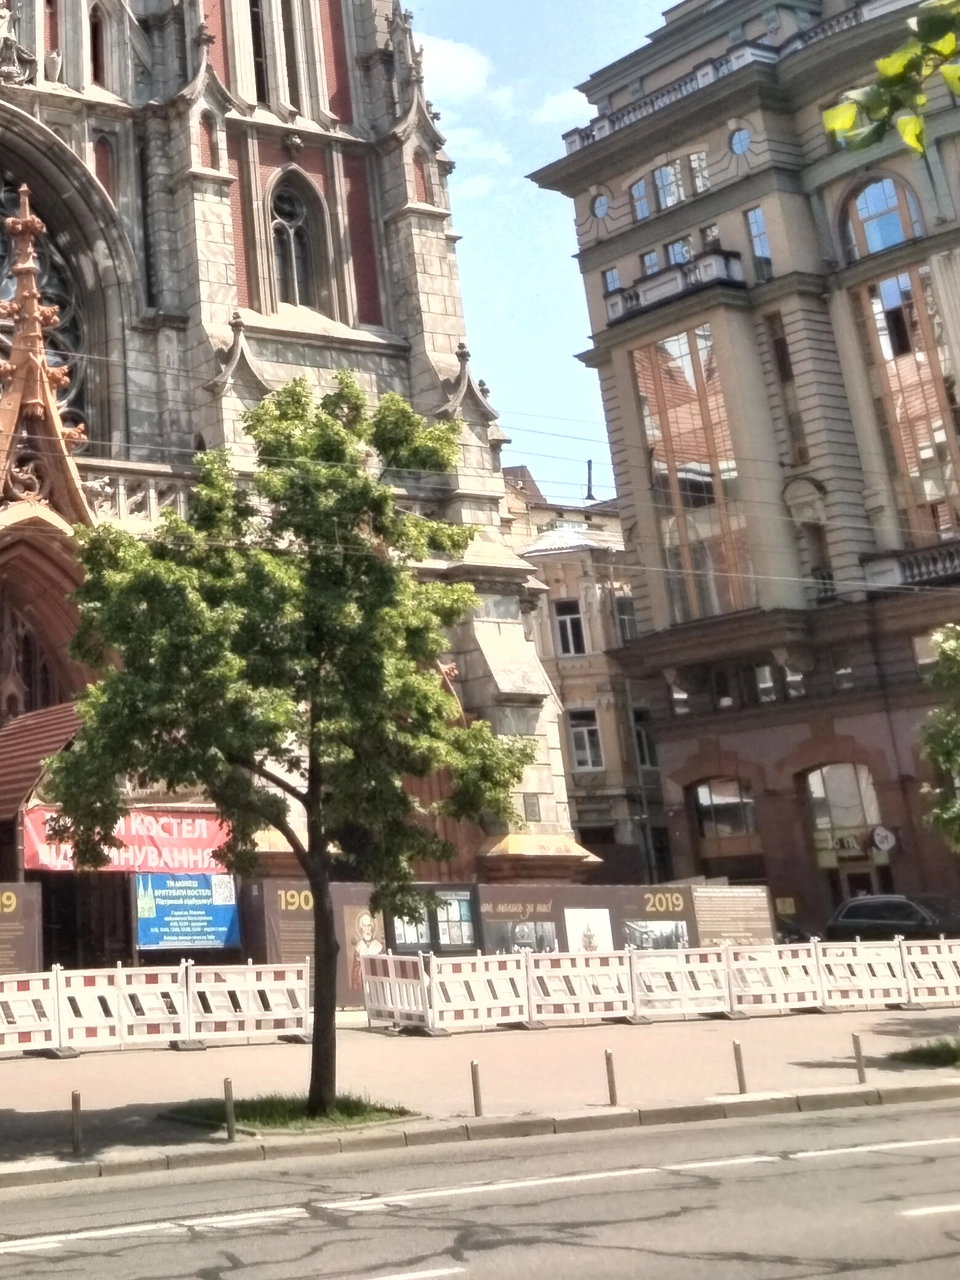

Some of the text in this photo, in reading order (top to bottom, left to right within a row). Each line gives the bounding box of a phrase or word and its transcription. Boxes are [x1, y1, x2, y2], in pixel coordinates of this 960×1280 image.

[131, 812, 208, 839] КОСТЕЛ
[154, 889, 187, 897] ВРЯТУВАТИ
[644, 893, 684, 912] 2019
